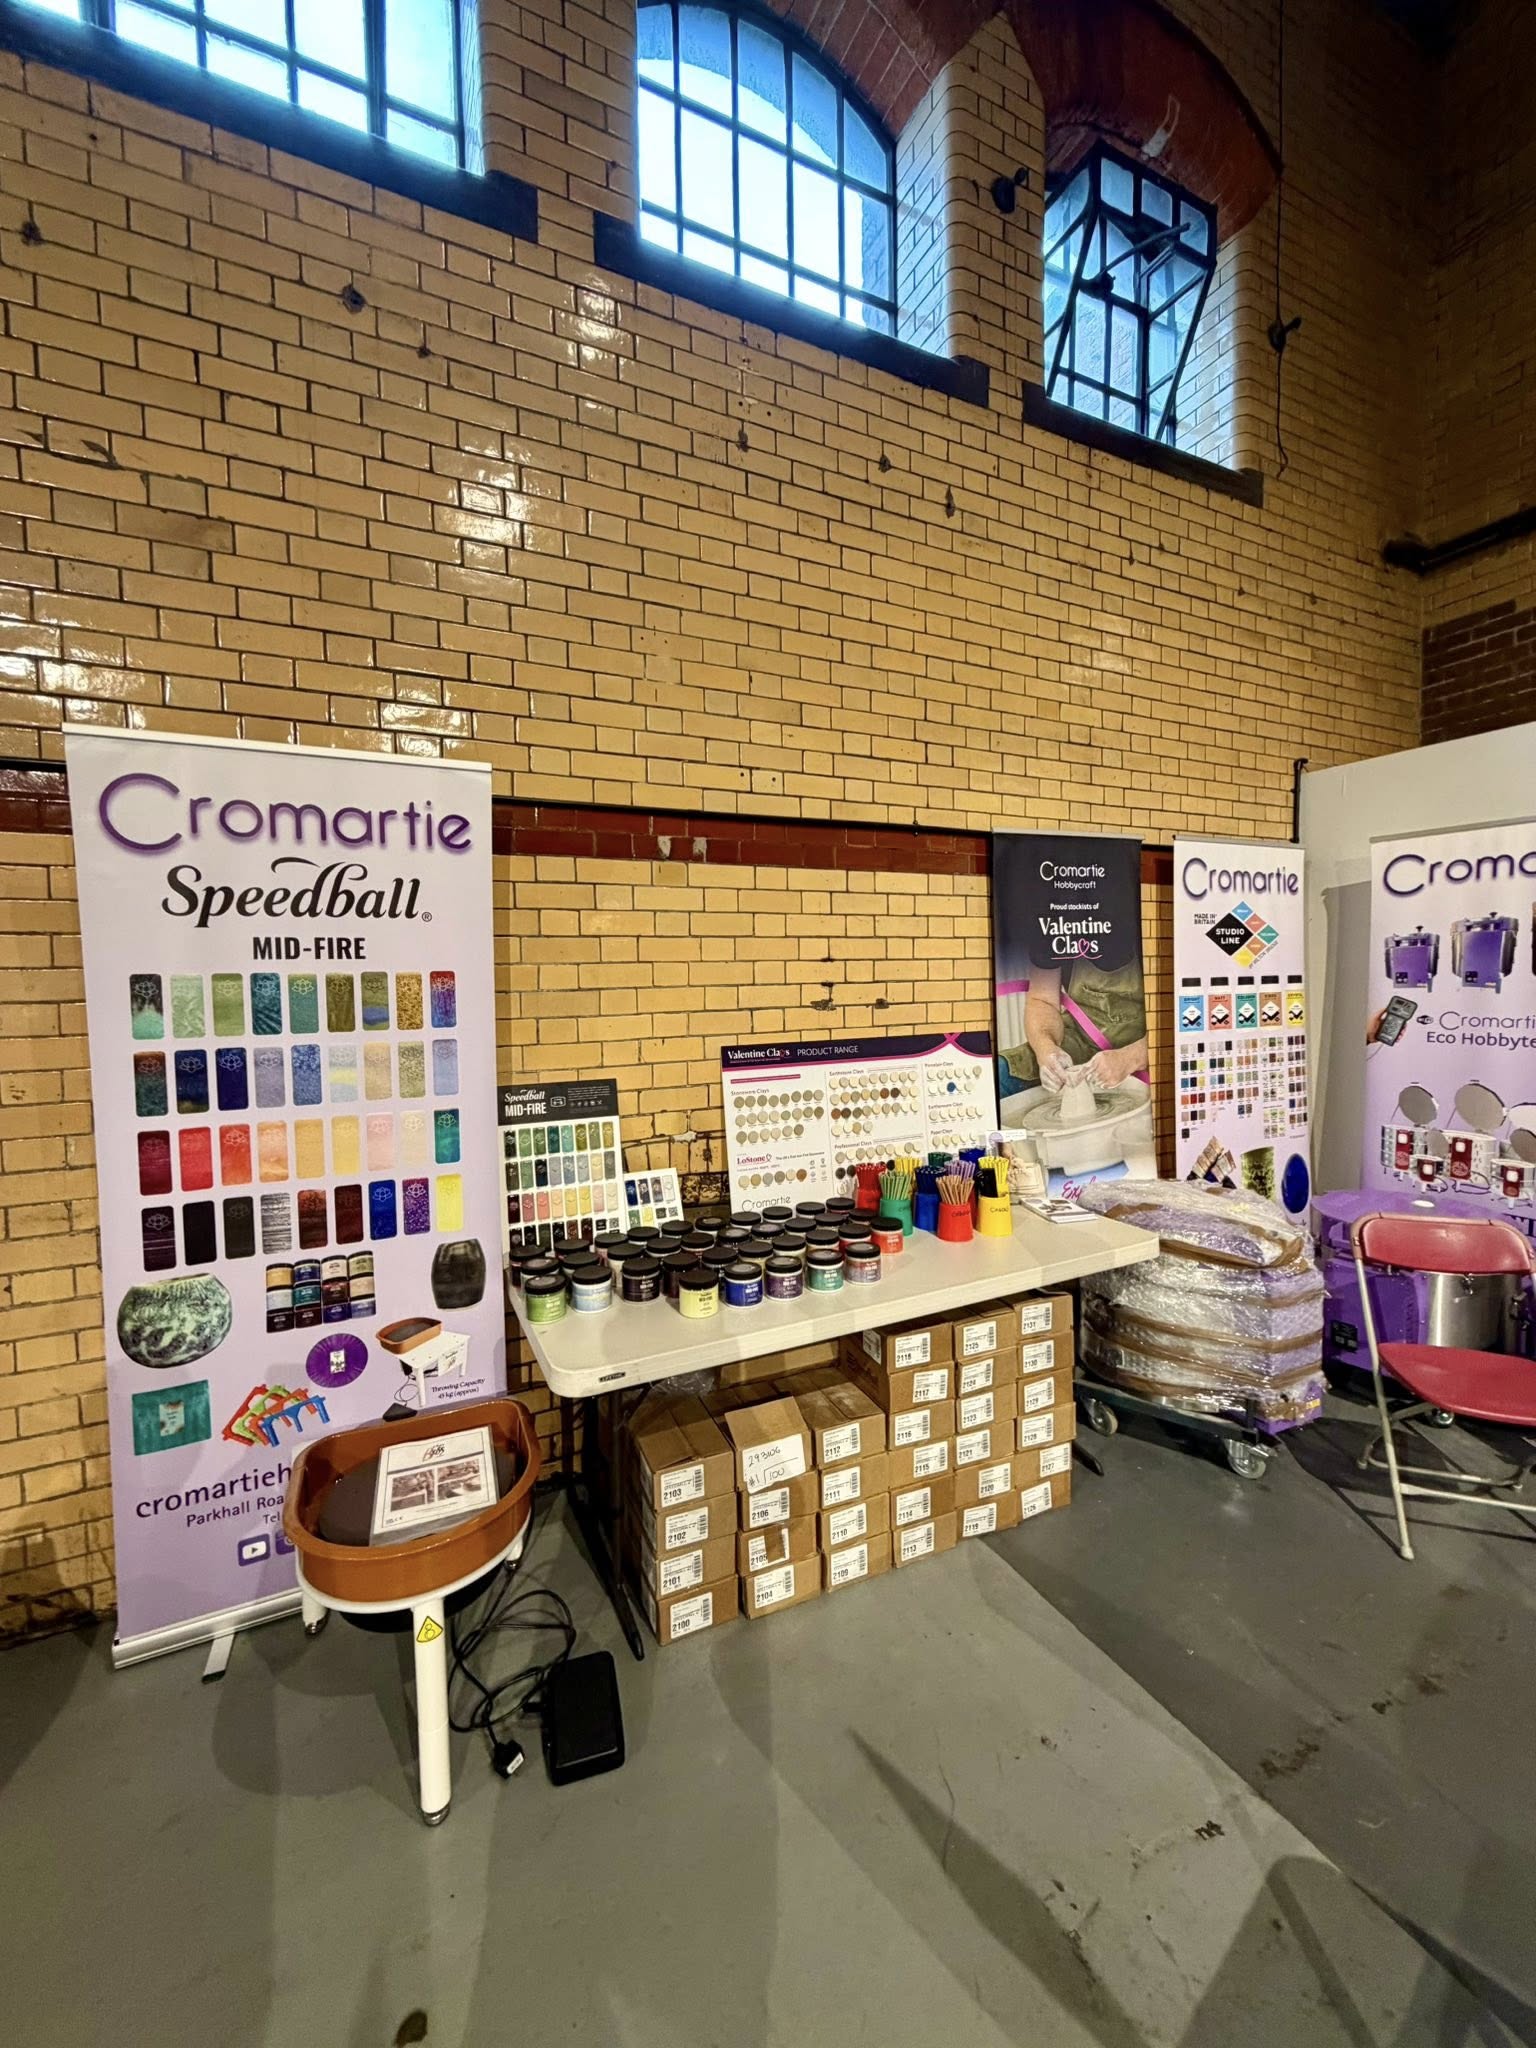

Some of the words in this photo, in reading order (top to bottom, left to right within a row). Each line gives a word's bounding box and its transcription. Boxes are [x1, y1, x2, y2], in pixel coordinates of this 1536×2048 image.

[98, 772, 473, 854] Cromartie
[1040, 861, 1106, 881] Cromartie
[1182, 857, 1299, 898] Cromartie
[1053, 880, 1097, 890] Hobbycraft
[1038, 916, 1112, 936] Valentine
[1215, 928, 1245, 936] STUDIO
[1220, 937, 1241, 945] LINE
[252, 936, 367, 960] MID-FIRE
[1427, 1031, 1457, 1044] Eco
[727, 1049, 766, 1060] Valentine
[797, 1046, 833, 1057] PRODUCT
[834, 1045, 859, 1055] RANGE
[505, 1088, 545, 1103] Speedball
[505, 1102, 547, 1117] MID-FIRE
[737, 1155, 766, 1165] LoStone
[459, 1378, 485, 1388] Capacity
[664, 1489, 682, 1500] 2103
[824, 1490, 840, 1500] 2111
[186, 1500, 250, 1528] Parkhall
[751, 1509, 769, 1520] 2106
[898, 1510, 913, 1520] 2114
[668, 1532, 686, 1544] 2102
[831, 1528, 848, 1540] 2110
[903, 1545, 917, 1556] 2113
[832, 1568, 849, 1580] 2109
[663, 1576, 681, 1588] 2101
[756, 1590, 773, 1602] 2104
[672, 1619, 690, 1632] 2100
